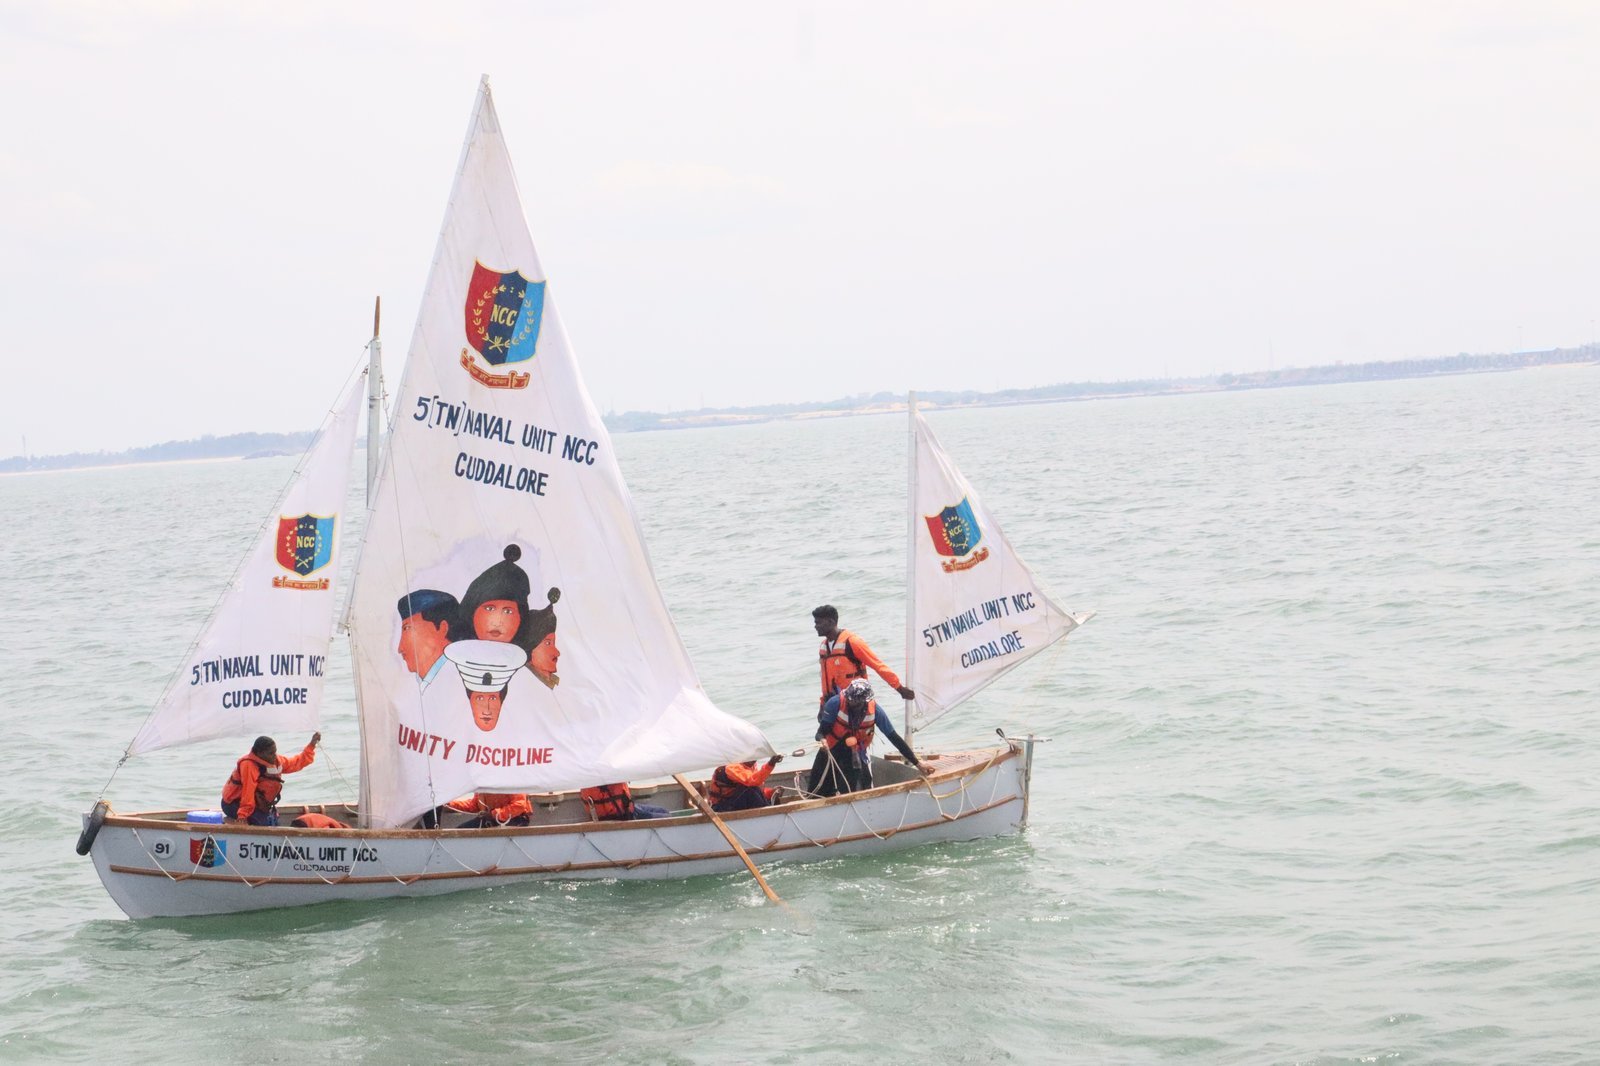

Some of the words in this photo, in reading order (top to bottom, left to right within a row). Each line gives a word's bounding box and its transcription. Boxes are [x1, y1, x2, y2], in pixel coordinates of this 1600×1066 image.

[490, 303, 518, 327] NCC
[522, 424, 557, 454] UNIT
[562, 435, 598, 465] NCC
[454, 452, 549, 496] CUDDALORE
[296, 536, 315, 548] NCC
[981, 597, 1010, 621] UNIT
[1011, 591, 1036, 614] NCC
[961, 630, 1025, 669] CUDDALORE
[270, 654, 304, 676] UNIT
[308, 655, 325, 677] NCC
[222, 687, 308, 709] CUDDALORE
[398, 723, 456, 760] UNITY
[465, 743, 554, 767] DISCIPLINE
[154, 843, 171, 855] 91
[318, 847, 347, 862] UNIT
[353, 847, 379, 862] NCC
[293, 863, 351, 873] CUDDALORE
